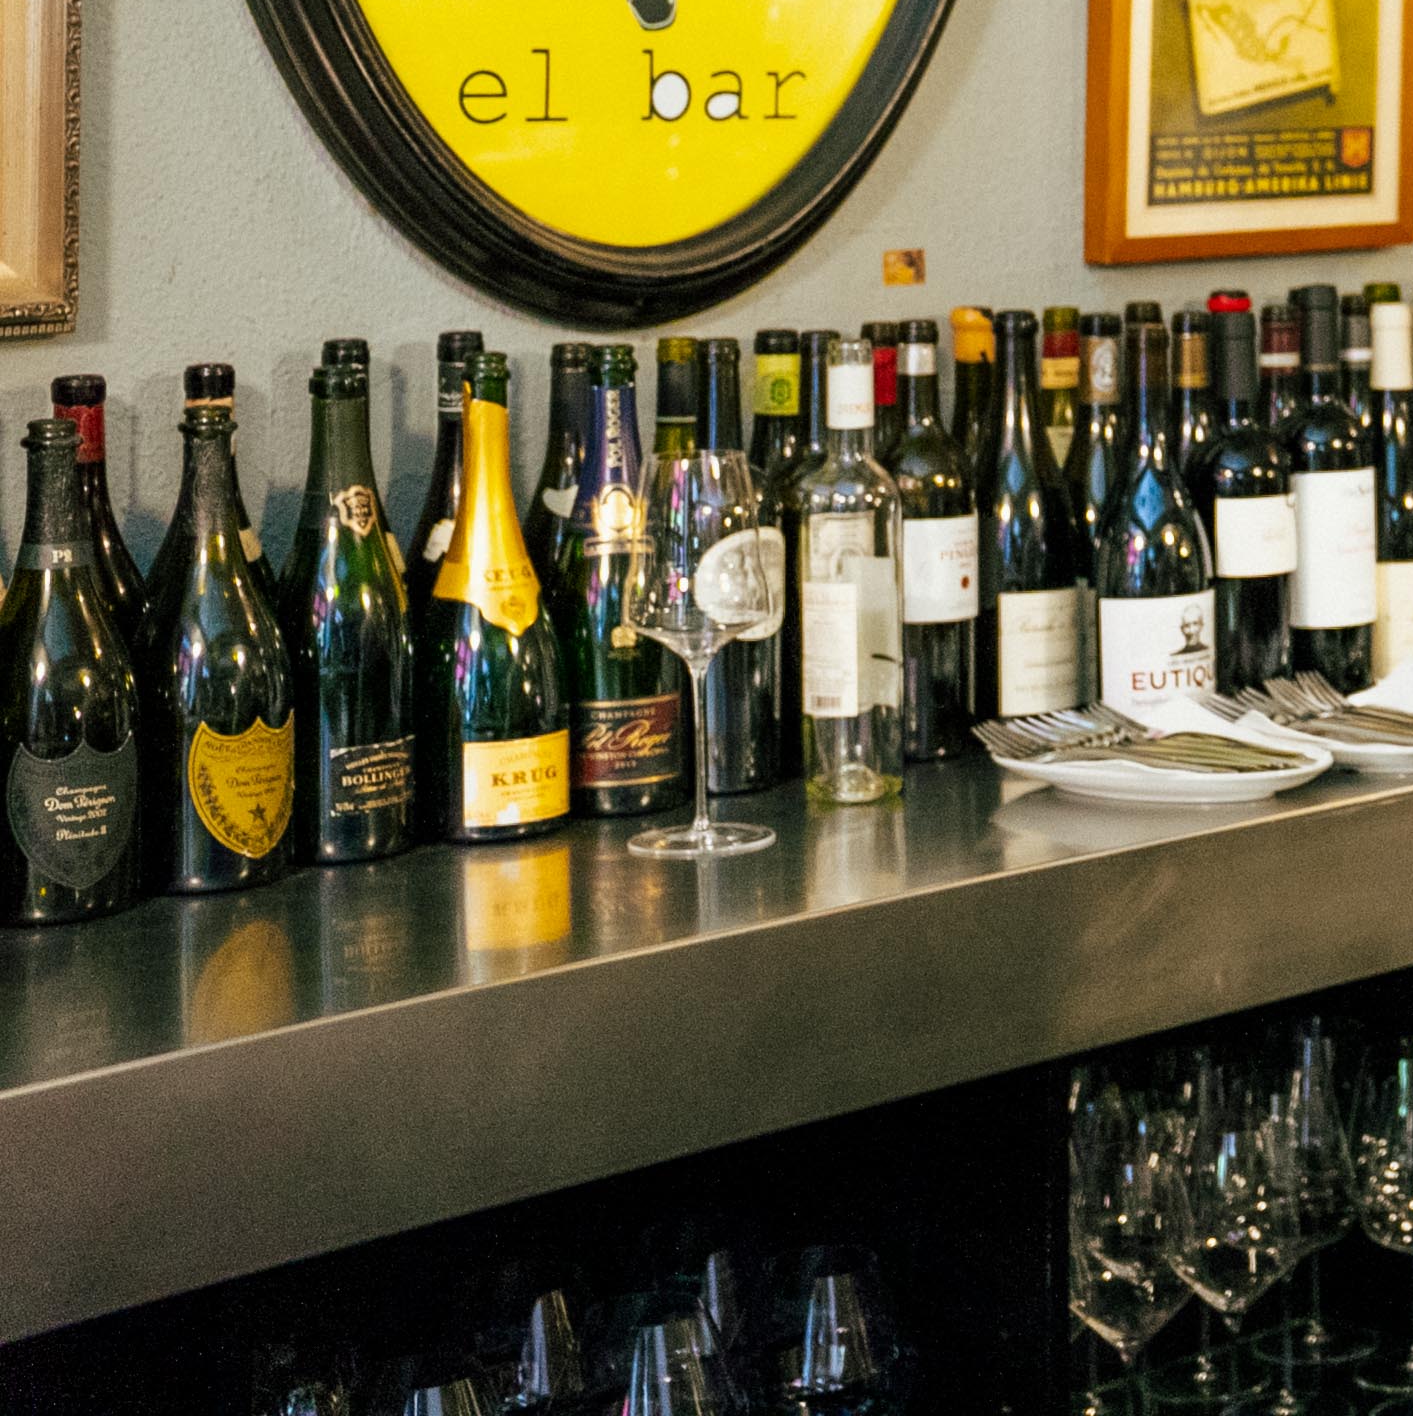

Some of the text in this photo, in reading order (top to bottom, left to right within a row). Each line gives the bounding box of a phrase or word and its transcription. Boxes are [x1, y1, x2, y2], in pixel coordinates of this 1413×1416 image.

[459, 49, 806, 124] el bar
[491, 765, 557, 787] KRUG
[44, 796, 73, 812] Dom
